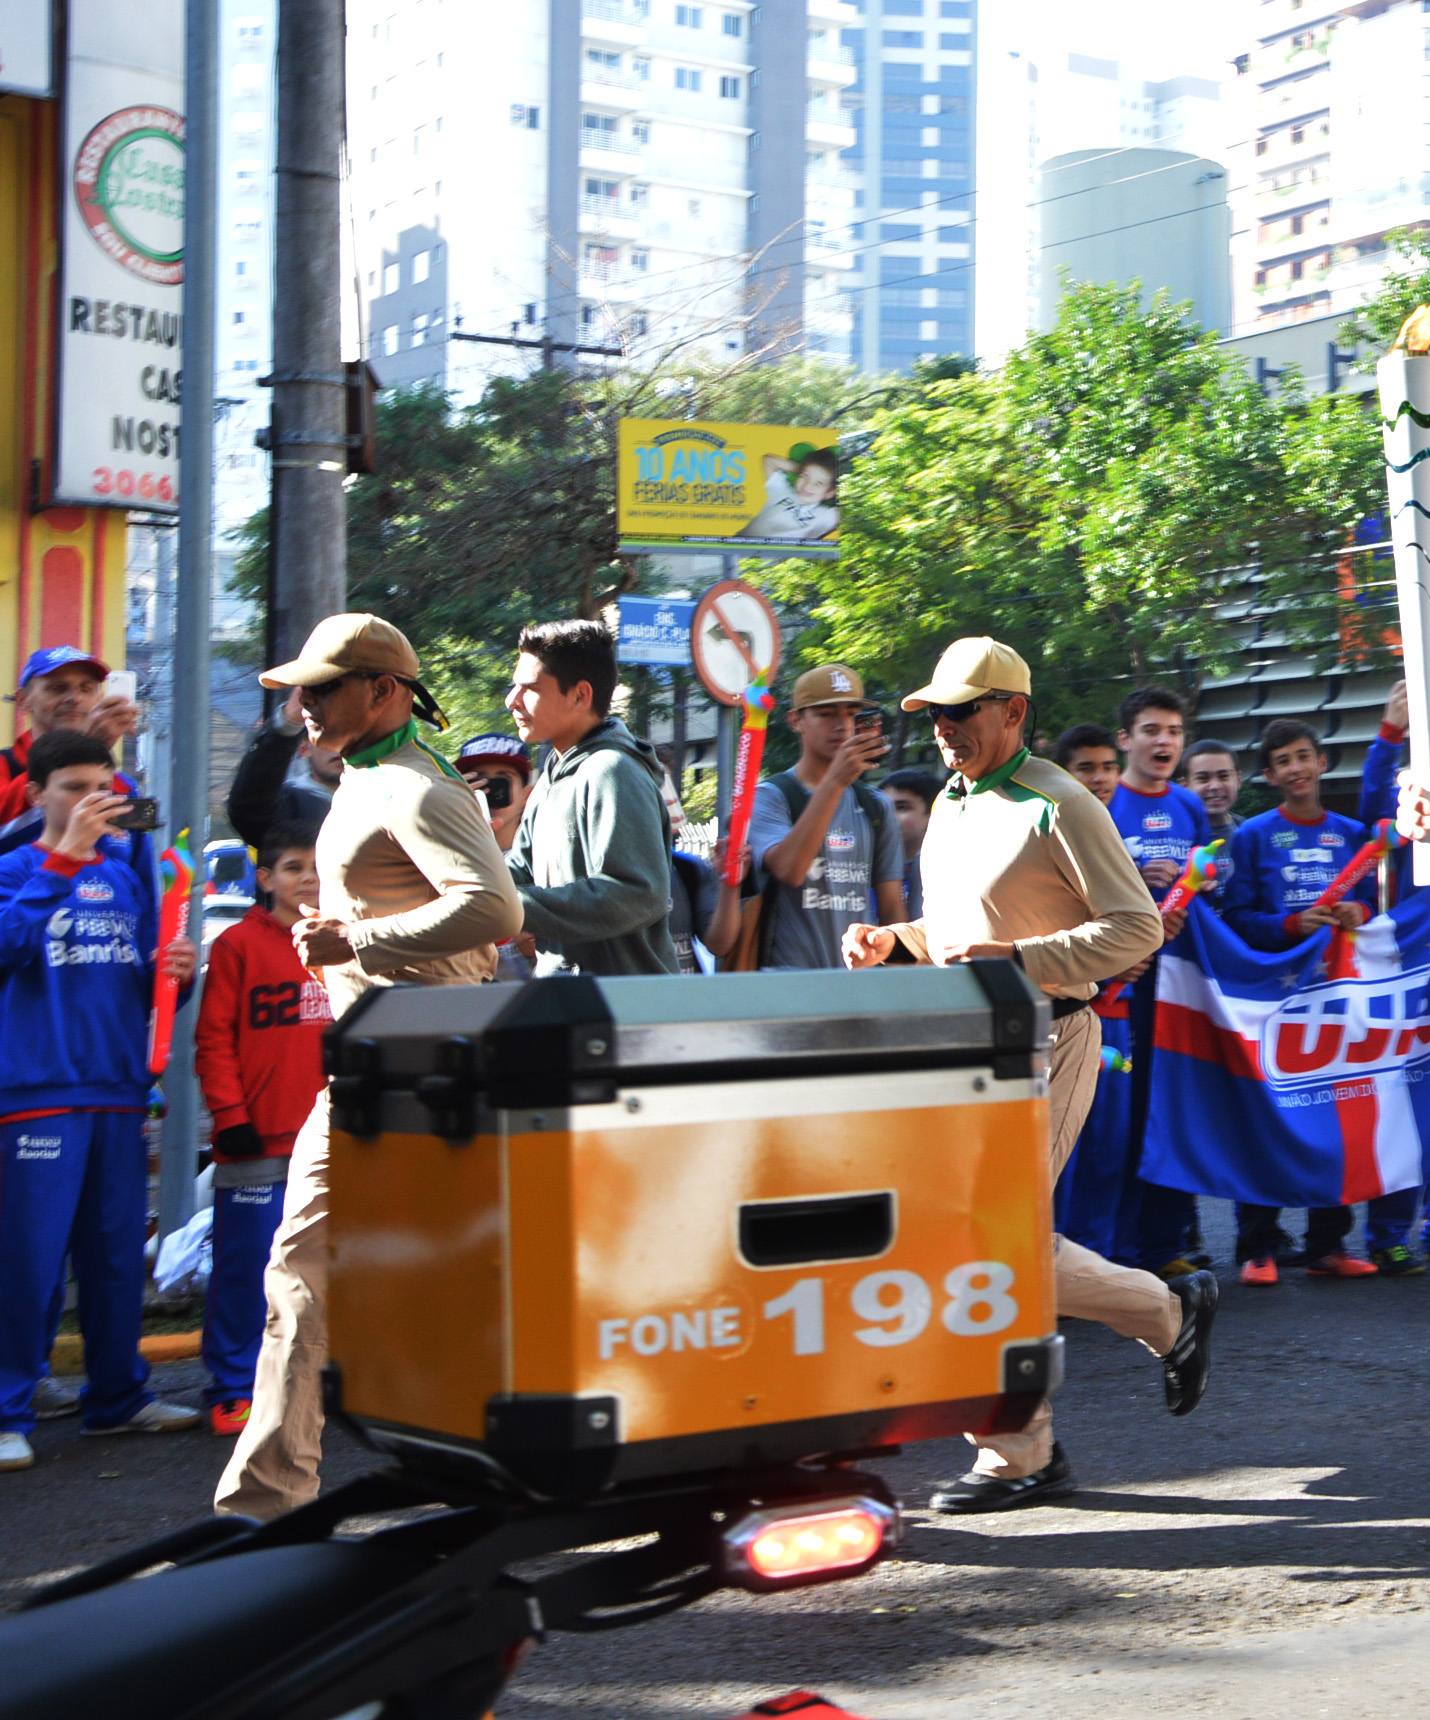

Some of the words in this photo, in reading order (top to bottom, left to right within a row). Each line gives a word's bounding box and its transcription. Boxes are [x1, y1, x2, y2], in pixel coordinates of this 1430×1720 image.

[69, 297, 184, 347] RESTAU
[141, 364, 183, 405] CAS
[112, 415, 181, 460] NOST
[92, 466, 180, 505] 3066.
[633, 447, 664, 482] 10
[669, 449, 747, 486] ANOS
[461, 737, 523, 757] THERAPY
[1143, 845, 1190, 859] FEEVAL
[802, 888, 866, 912] Banris
[249, 982, 300, 1030] 62
[599, 1307, 741, 1360] FONE
[764, 1261, 1019, 1356] 198
